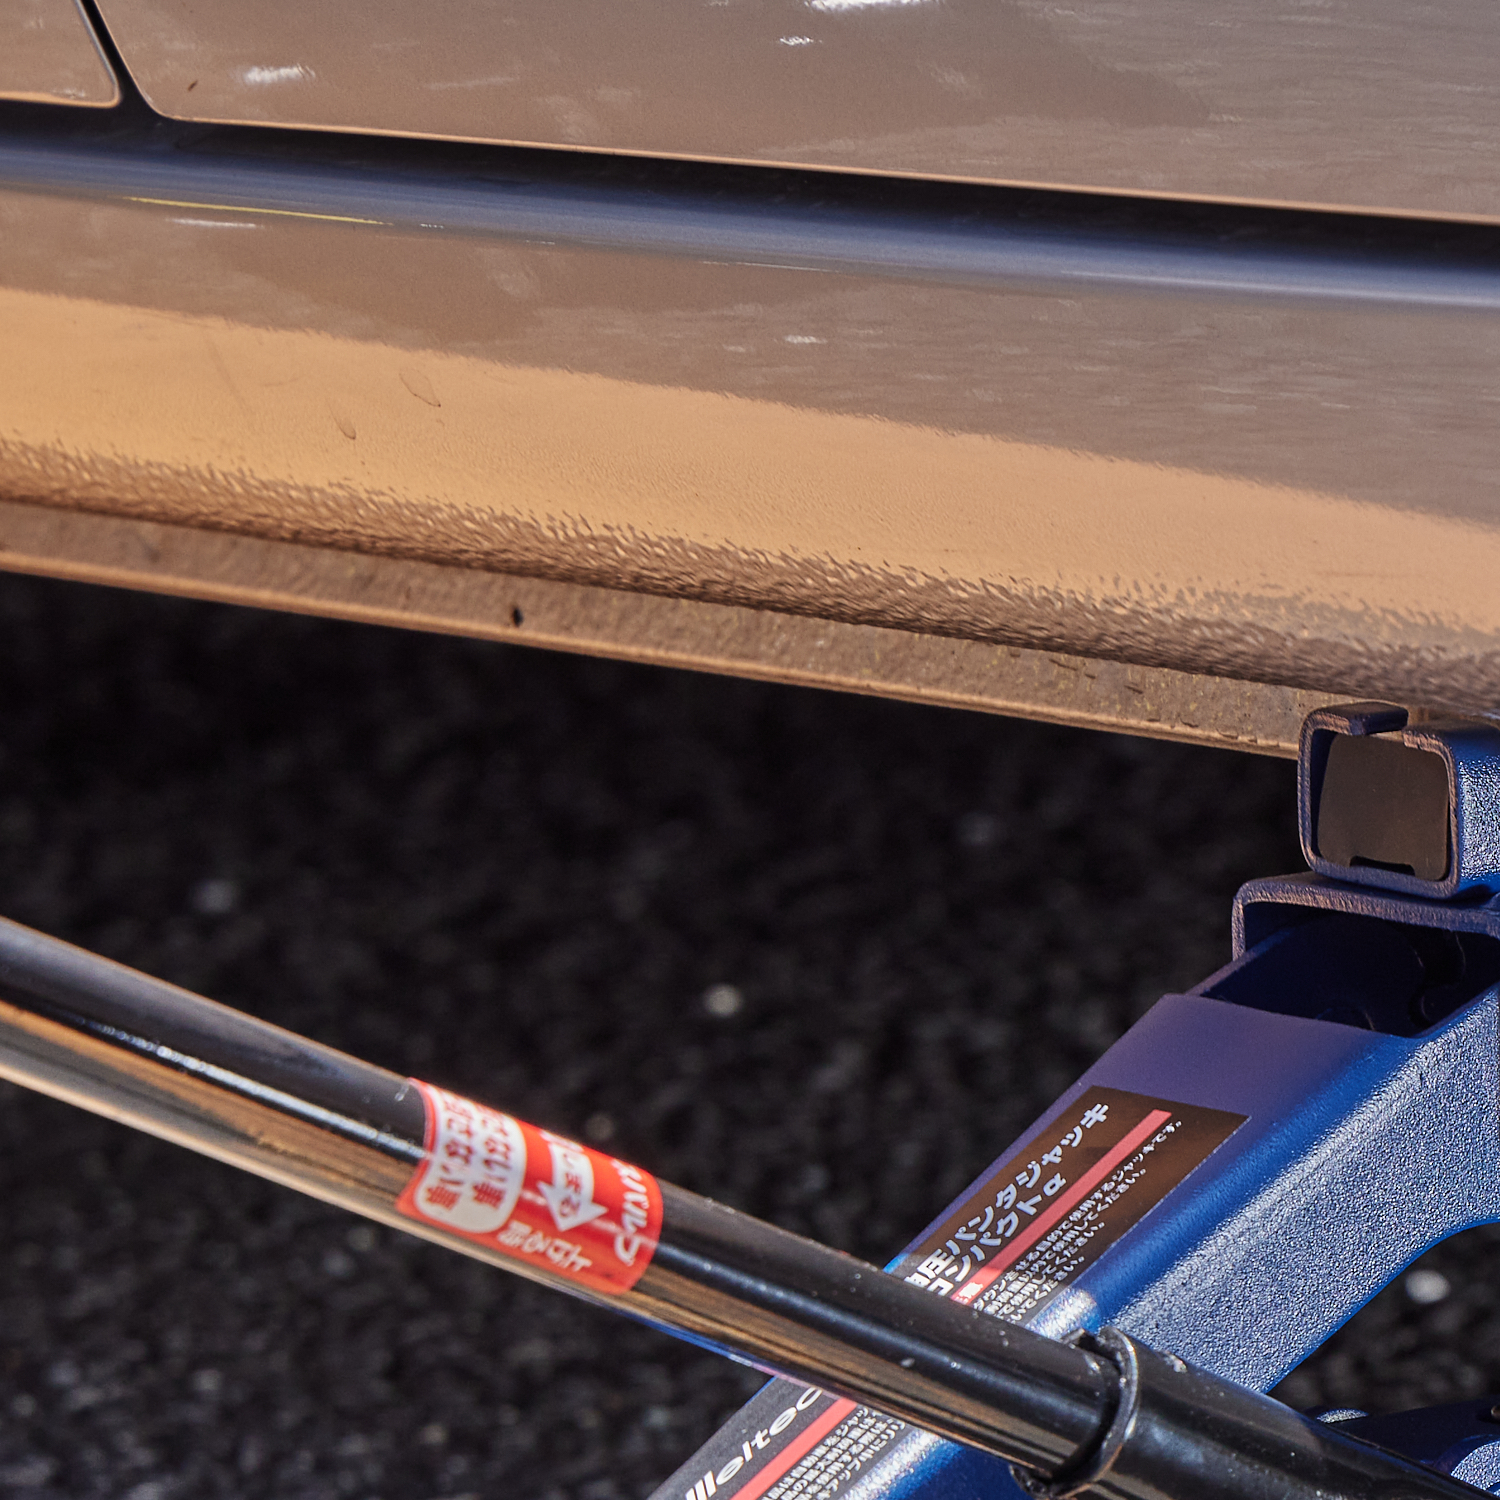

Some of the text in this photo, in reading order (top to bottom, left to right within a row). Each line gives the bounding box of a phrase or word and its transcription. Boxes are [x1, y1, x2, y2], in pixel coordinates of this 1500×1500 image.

[927, 1173, 1066, 1296] コンパクトα
[994, 1222, 1105, 1320] で使用してください。
